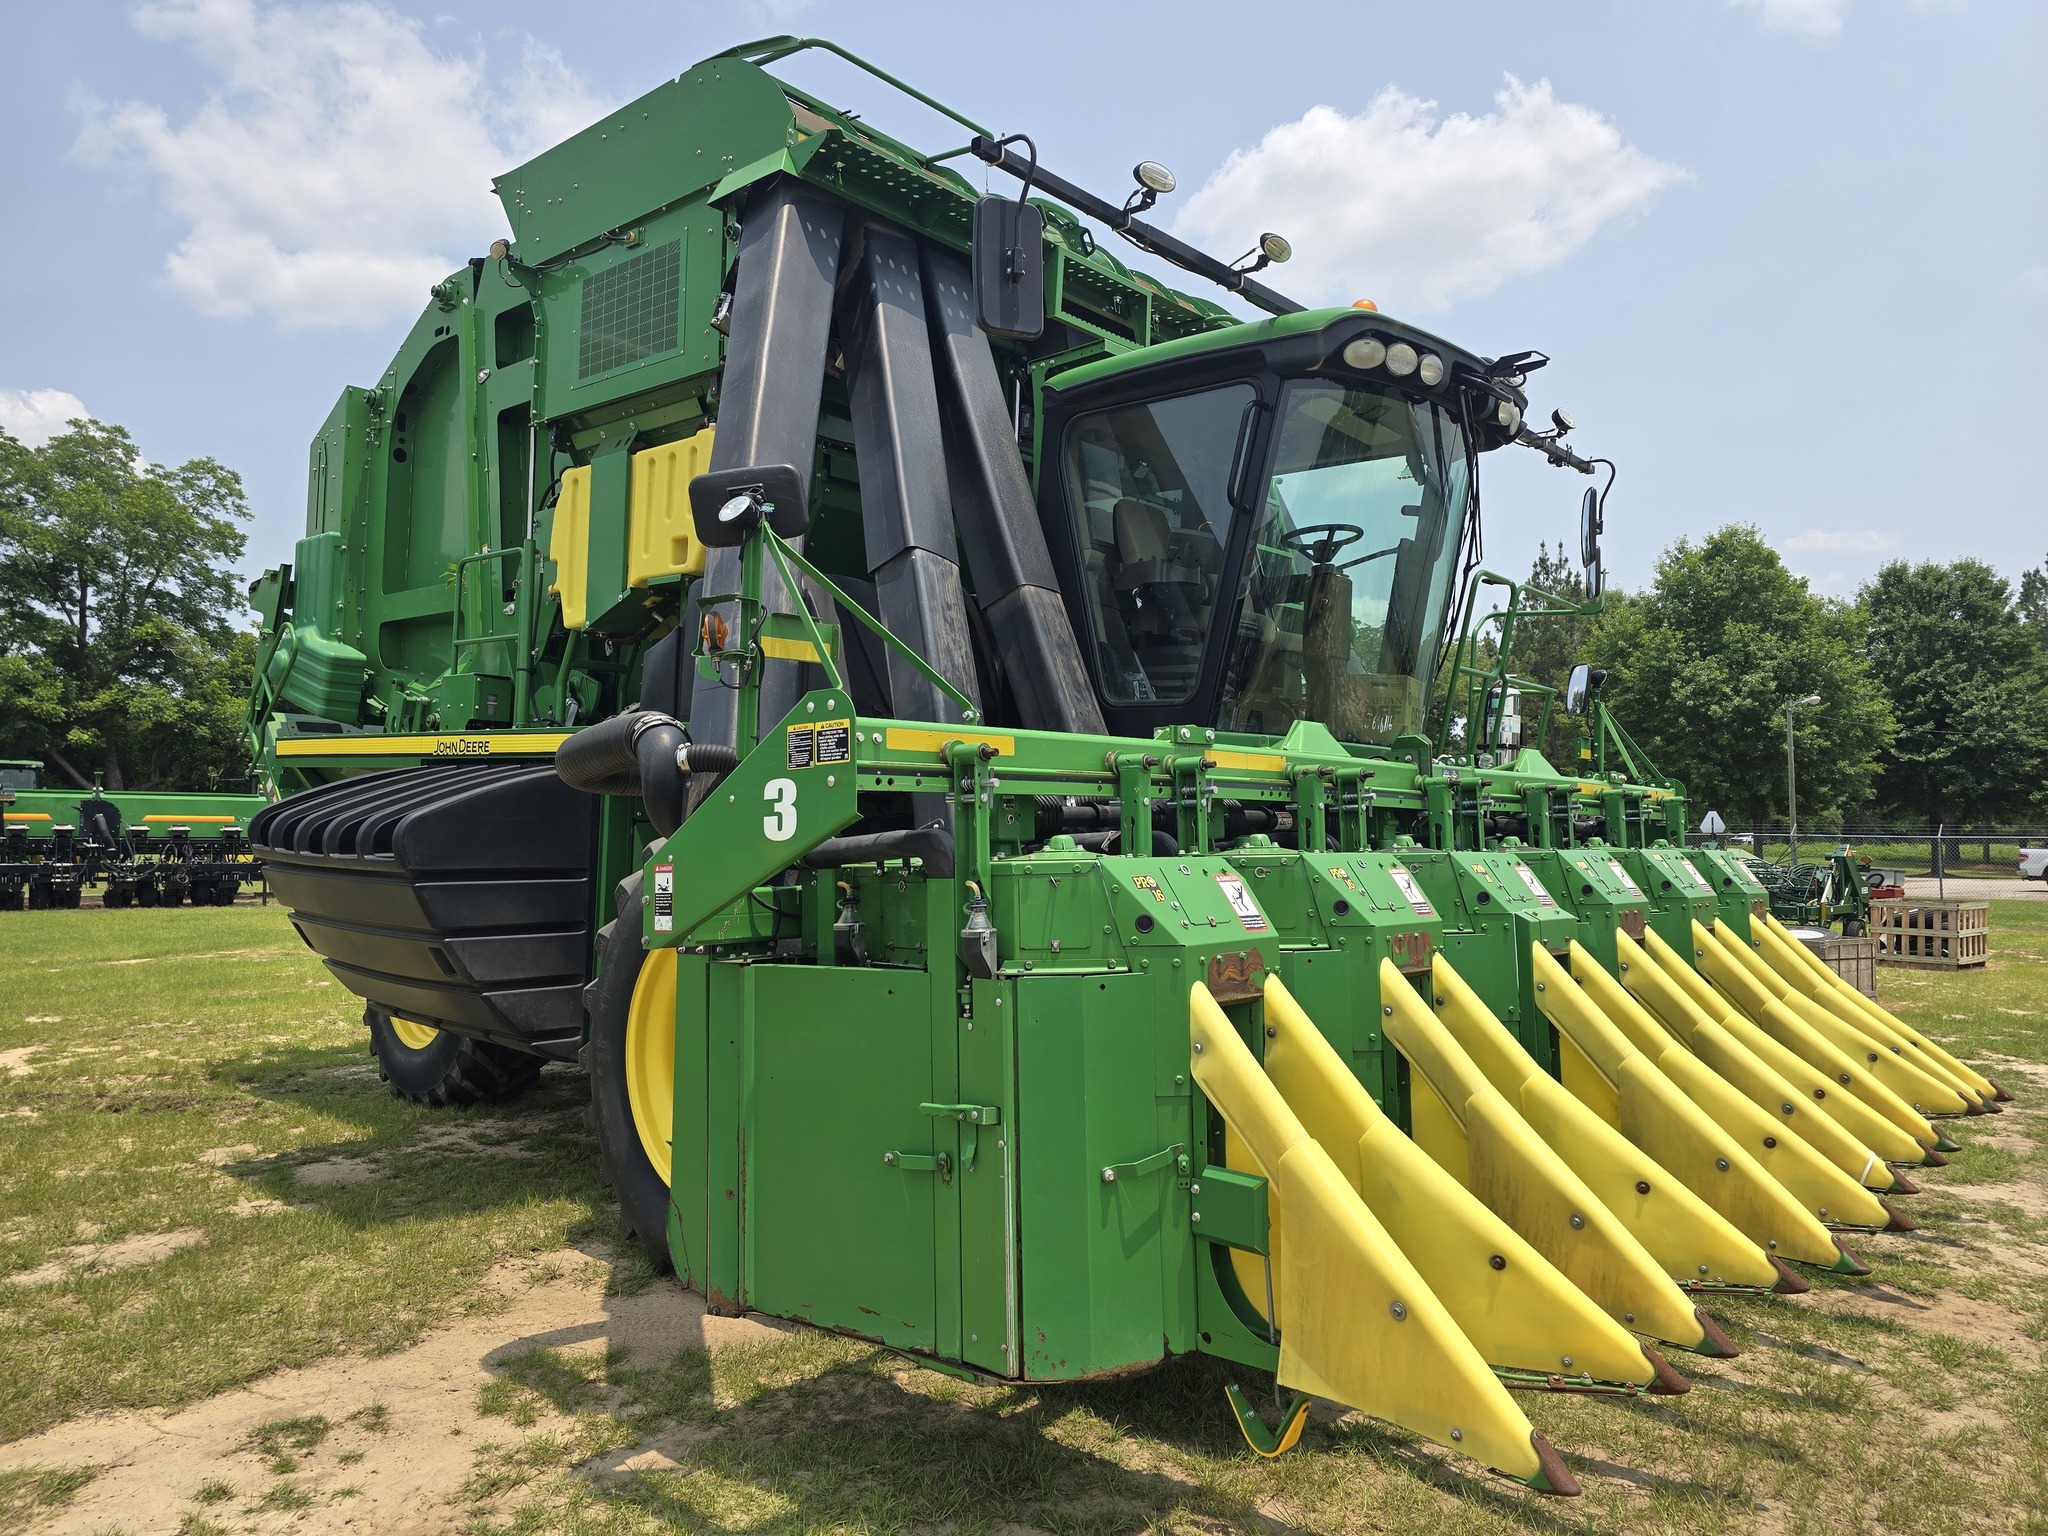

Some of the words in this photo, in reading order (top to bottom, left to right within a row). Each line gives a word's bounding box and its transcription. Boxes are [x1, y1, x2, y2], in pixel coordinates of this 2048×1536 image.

[825, 721, 845, 729] CAUTION
[433, 740, 458, 755] JOHN
[458, 739, 490, 754] DEERE
[763, 777, 798, 842] 3
[1133, 876, 1157, 889] PRO
[1344, 879, 1356, 889] 16
[1151, 889, 1166, 902] 16
